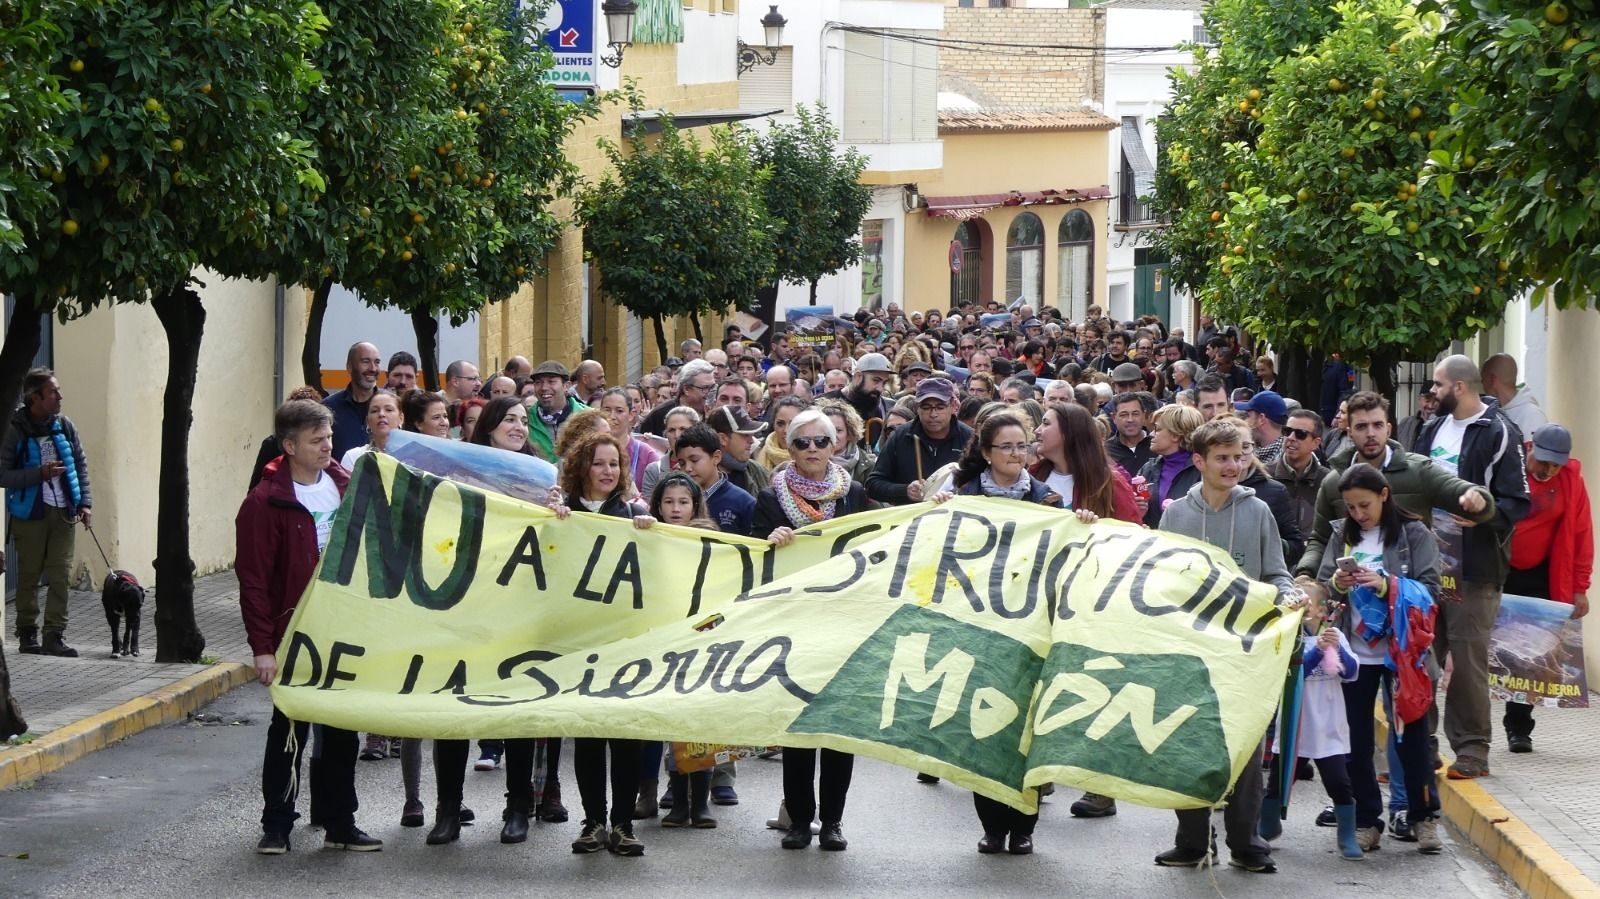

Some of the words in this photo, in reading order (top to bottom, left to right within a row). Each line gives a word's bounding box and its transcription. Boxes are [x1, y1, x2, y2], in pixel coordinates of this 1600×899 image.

[553, 57, 593, 66] LIENTES
[542, 71, 591, 82] ADONA
[318, 450, 487, 611] NO
[496, 525, 548, 592] A
[573, 534, 644, 610] LA
[279, 630, 366, 691] DE
[1501, 674, 1530, 691] PARA
[1532, 679, 1545, 694] LA
[1548, 683, 1581, 696] SIERRA
